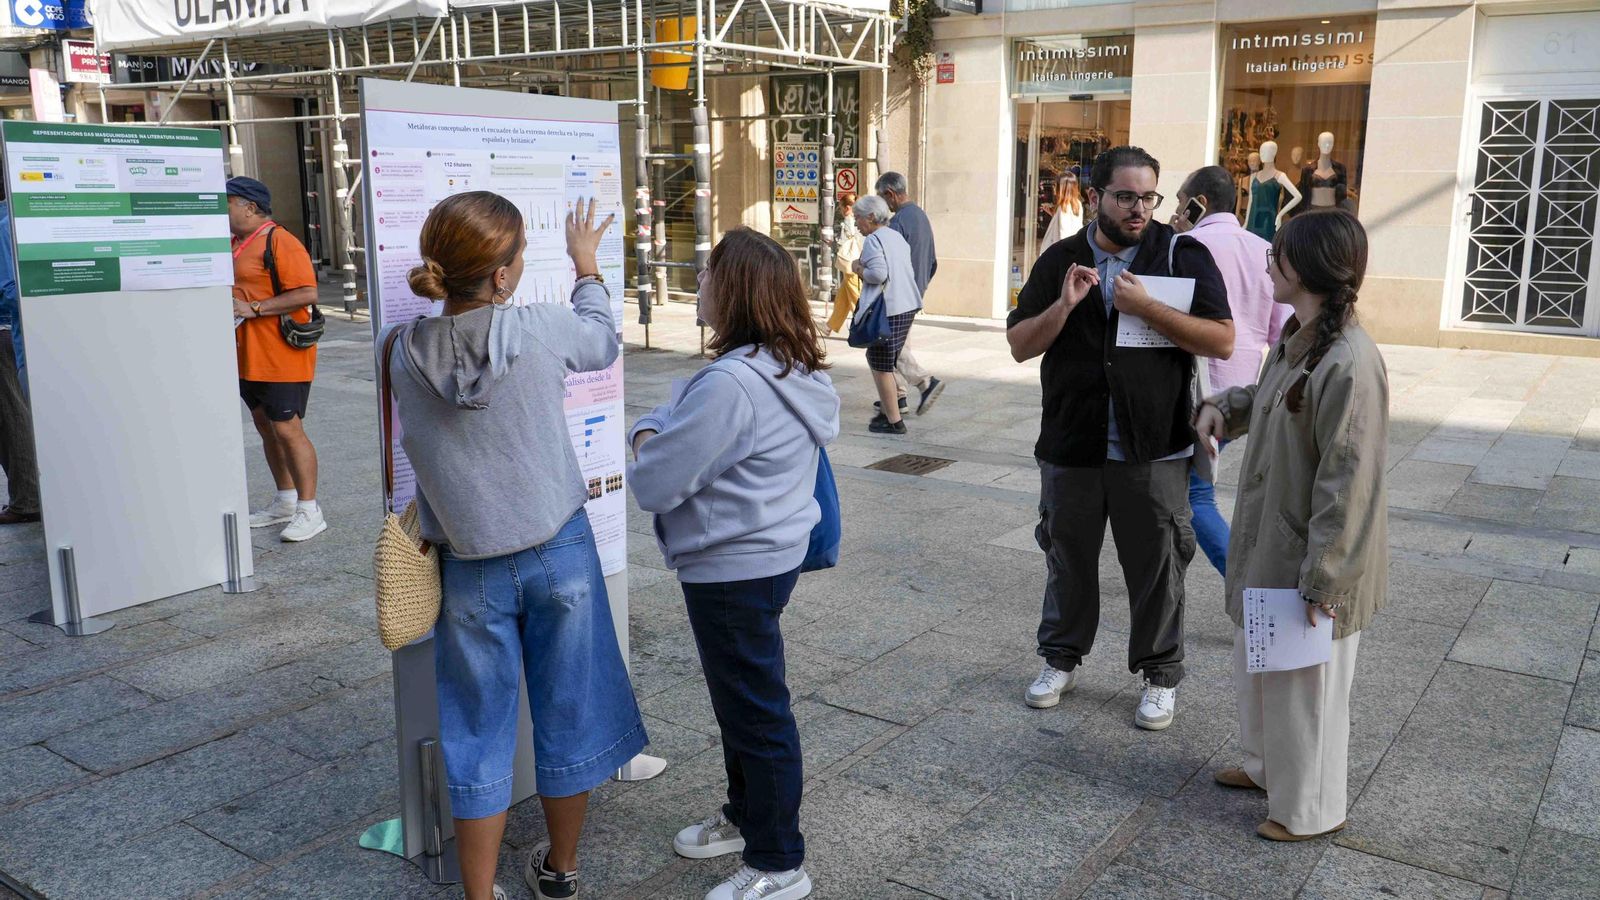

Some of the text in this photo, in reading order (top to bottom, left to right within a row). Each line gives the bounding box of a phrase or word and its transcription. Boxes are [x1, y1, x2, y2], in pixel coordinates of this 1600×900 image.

[46, 12, 64, 20] VIGO
[1246, 60, 1346, 73] Italian lingerie
[1032, 69, 1114, 83] Italian lingerie
